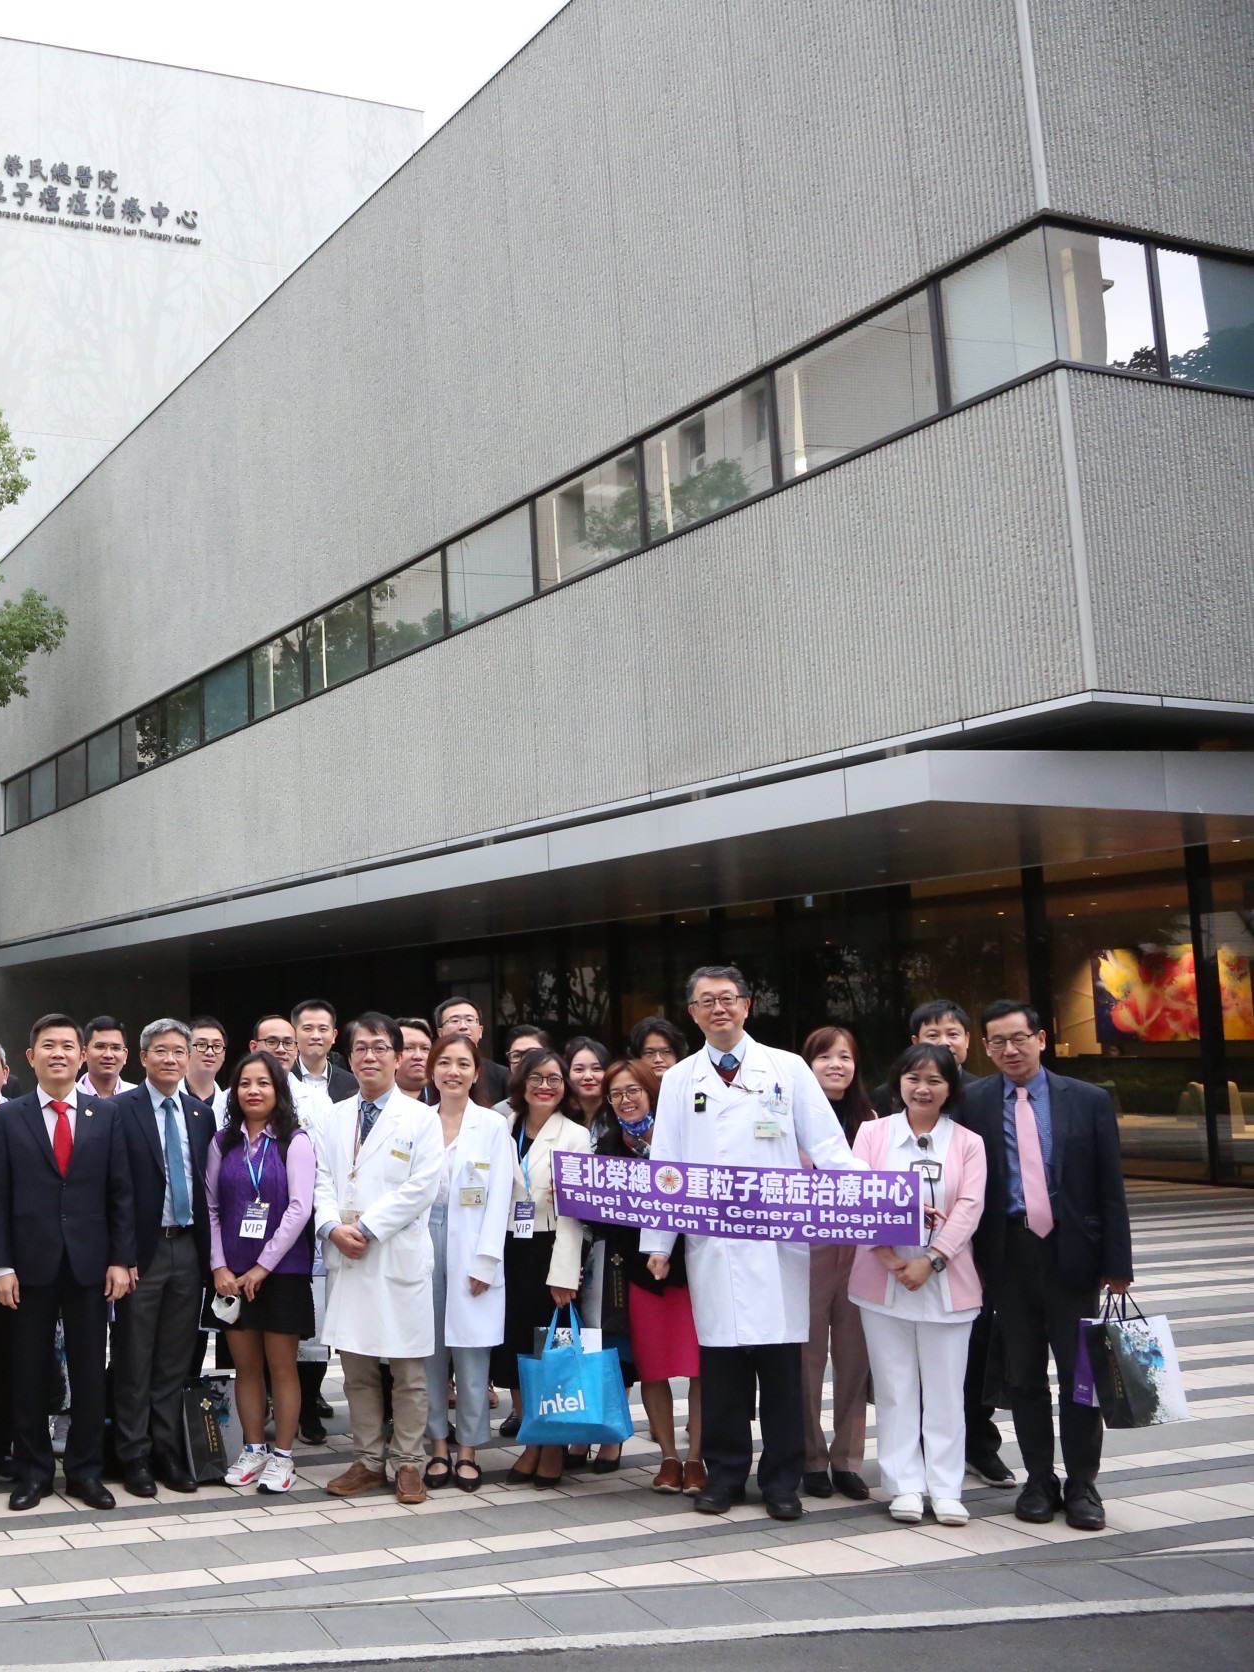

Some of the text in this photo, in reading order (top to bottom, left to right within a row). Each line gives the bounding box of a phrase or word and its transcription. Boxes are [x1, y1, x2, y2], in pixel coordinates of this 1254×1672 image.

[23, 212, 56, 225] General
[58, 216, 93, 231] Hospital
[95, 222, 121, 235] Heavy
[123, 227, 137, 236] Ion
[138, 229, 172, 242] Therapy
[174, 233, 202, 246] Center
[560, 1155, 914, 1208] 臺北榮總 重粒子癌症治療中心
[562, 1188, 913, 1227] Taipei Veterans General Hospital
[600, 1207, 877, 1240] Heavy Ion Therapy Center
[244, 1223, 262, 1233] VIP
[515, 1223, 531, 1234] VIP
[538, 1384, 585, 1416] intel
